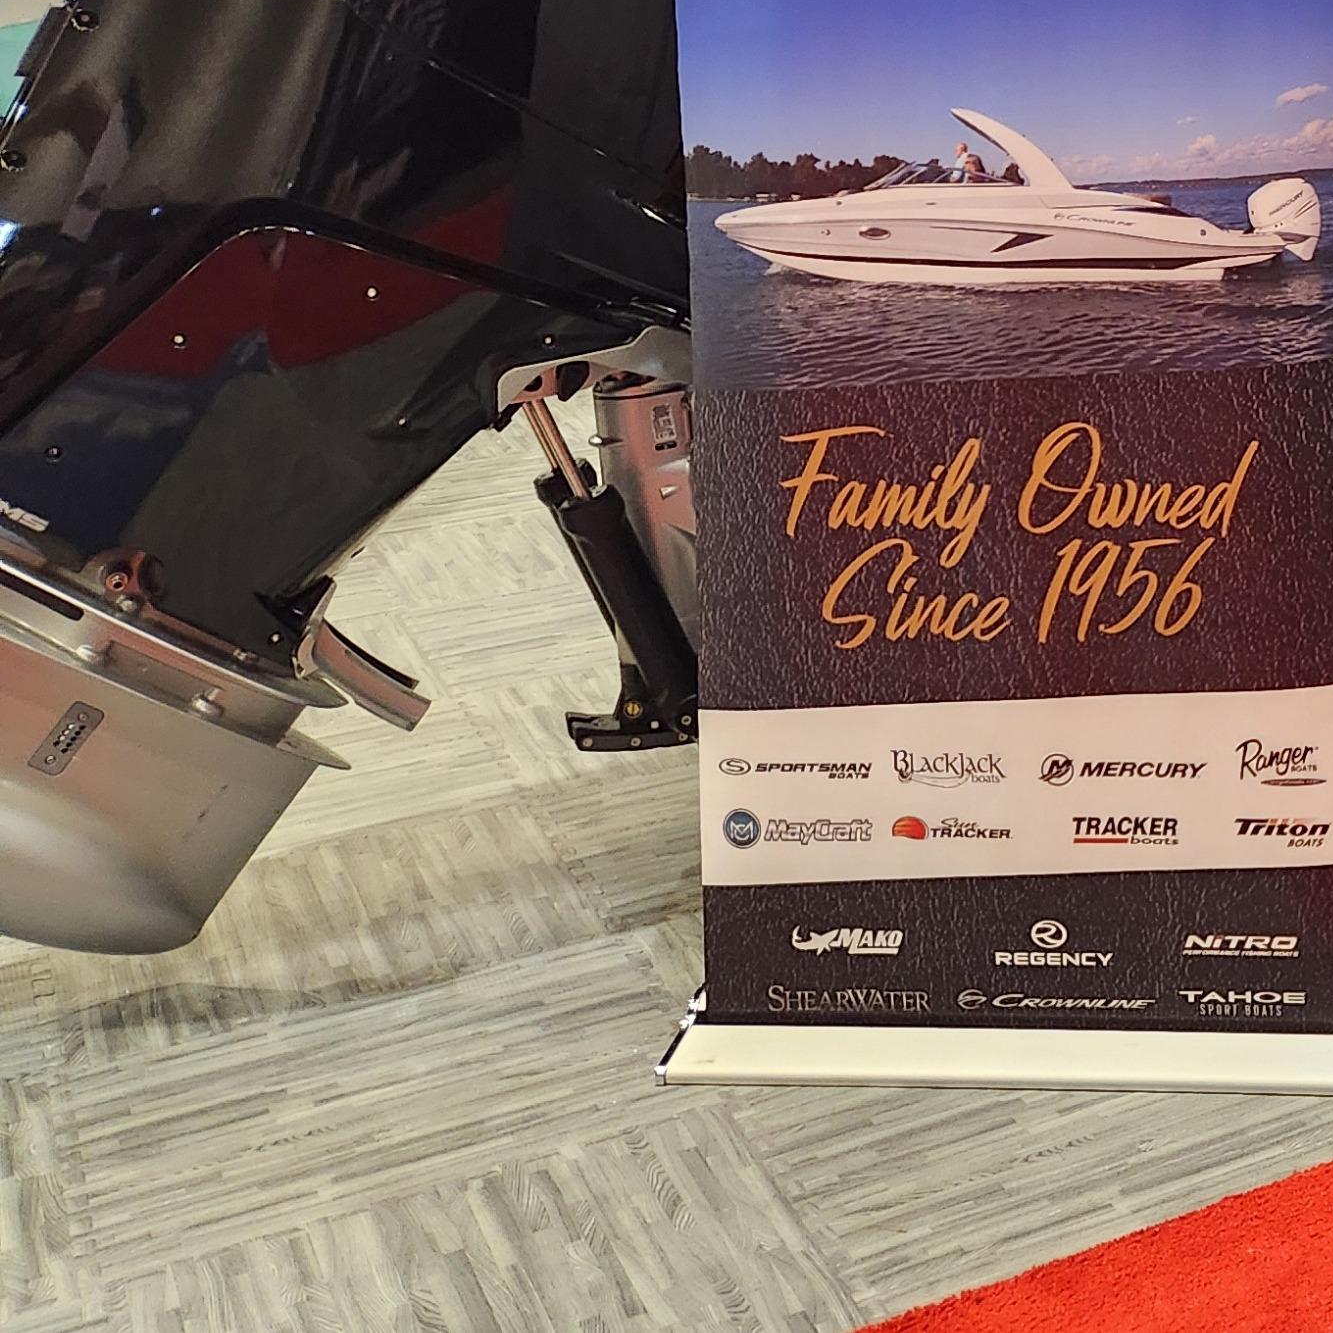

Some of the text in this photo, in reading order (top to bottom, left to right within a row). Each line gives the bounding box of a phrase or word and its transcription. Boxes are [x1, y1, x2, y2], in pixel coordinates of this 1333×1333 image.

[779, 421, 1260, 569] Family Owned
[820, 537, 1218, 650] Since 1956
[1234, 739, 1319, 780] Ranger
[755, 762, 872, 774] SPORTSMAN
[1079, 761, 1208, 778] MERCURY
[1290, 764, 1318, 773] BOATS
[970, 772, 1001, 784] boats
[940, 817, 979, 830] Sun
[1072, 816, 1179, 836] TRACKER
[1234, 818, 1333, 837] Triton
[763, 818, 873, 845] MayCraft
[930, 827, 1012, 839] TRACKER
[1129, 835, 1180, 845] boats
[1286, 838, 1325, 848] BOATS
[994, 951, 1113, 967] REGENCY
[991, 993, 1156, 1010] CROWNLINE
[1178, 990, 1306, 1005] TAHOE
[1199, 1003, 1283, 1017] SPORT BOATS
